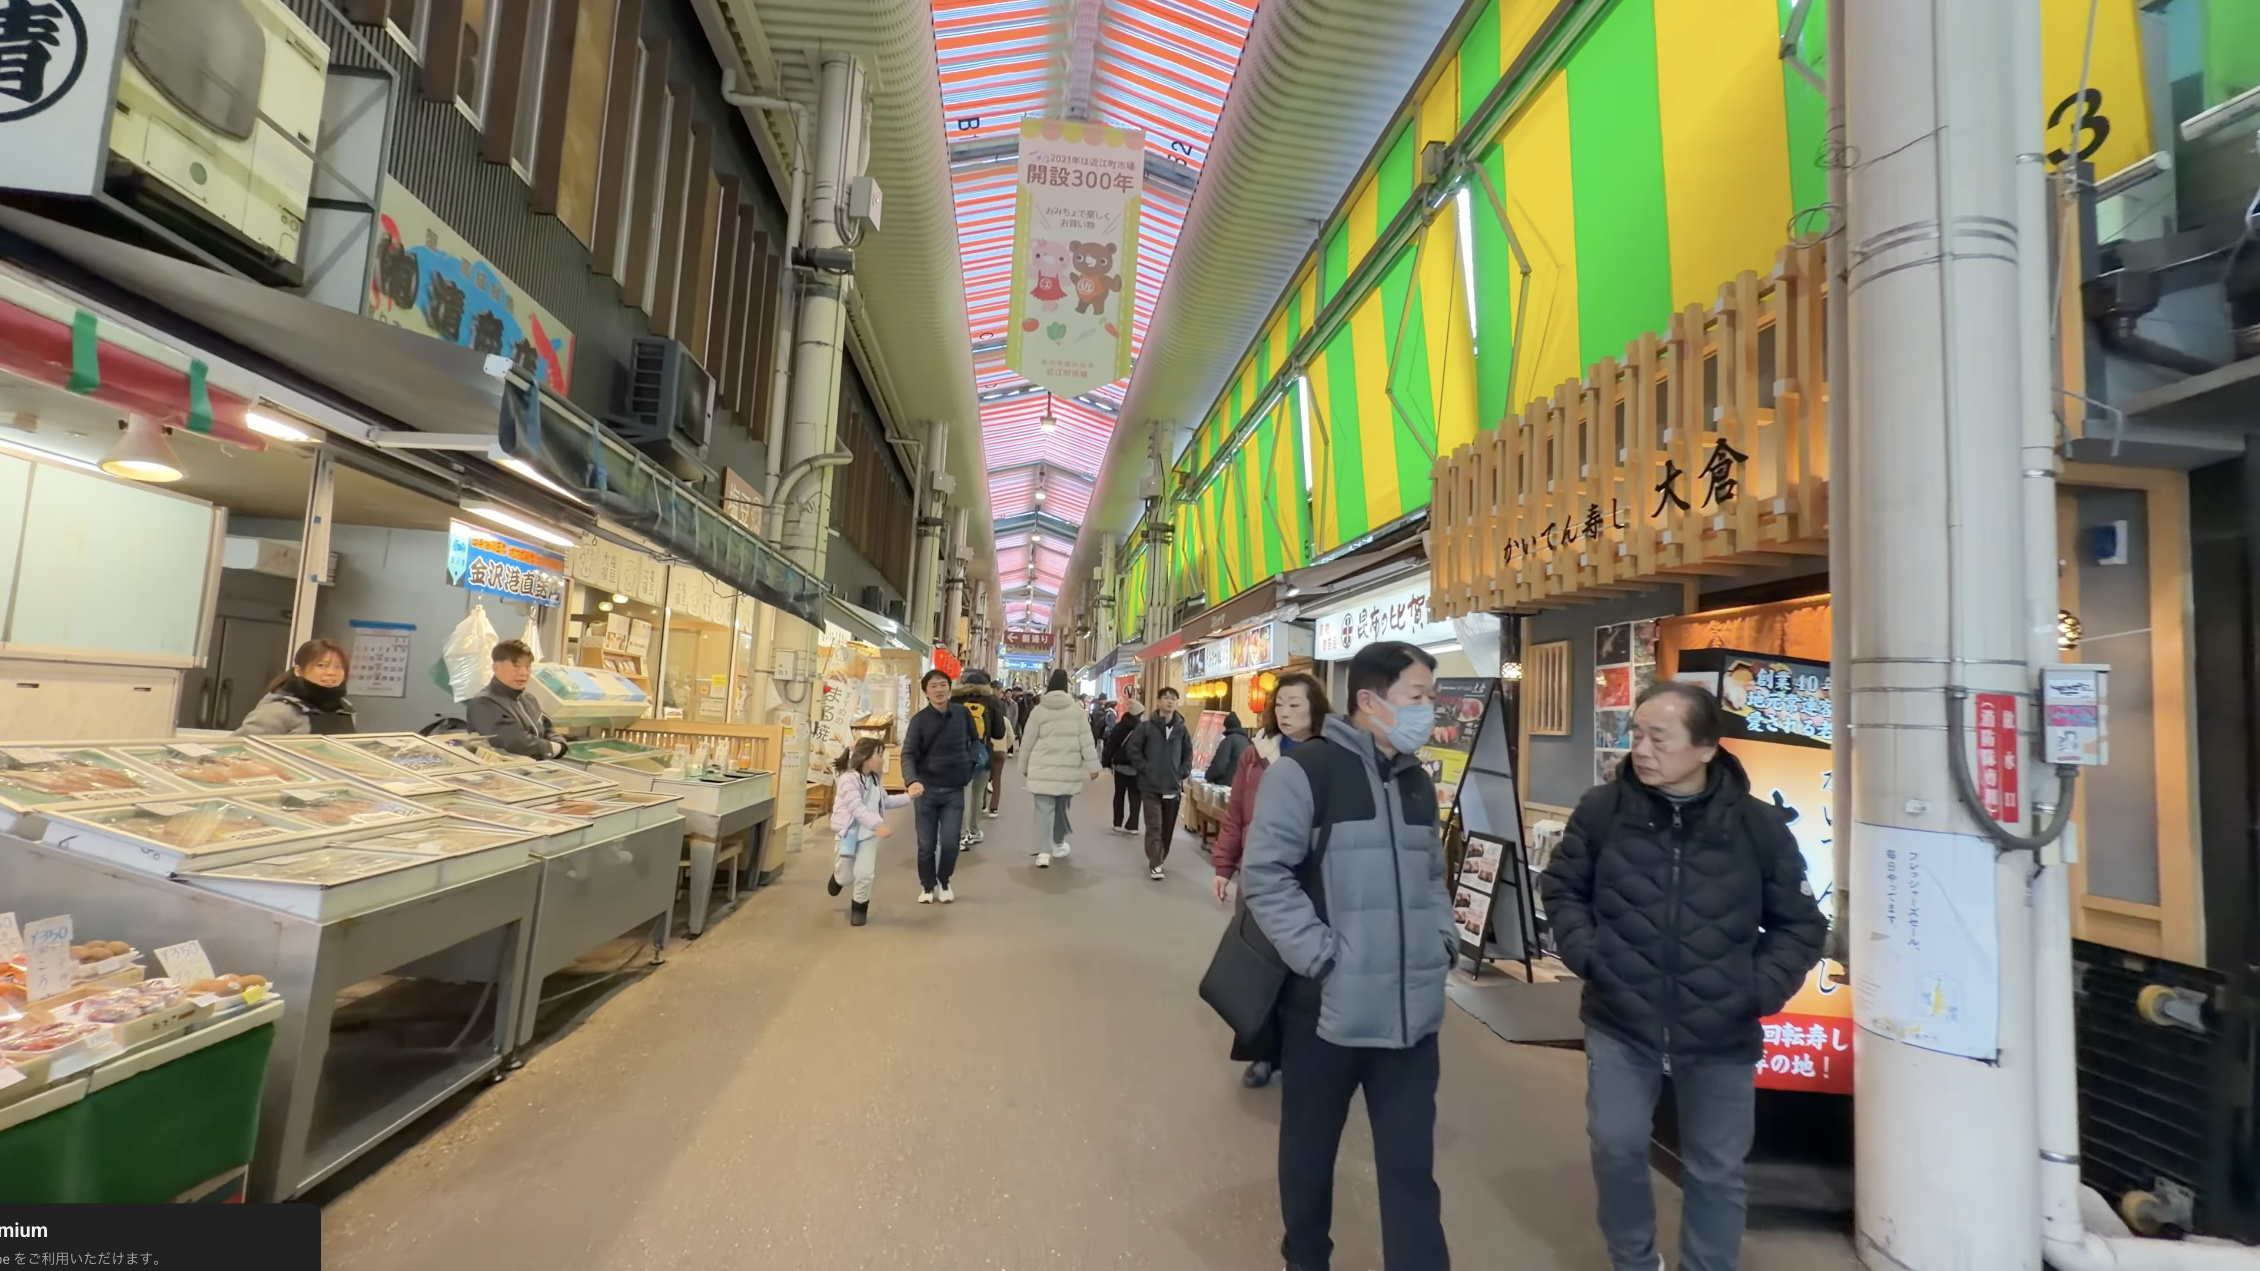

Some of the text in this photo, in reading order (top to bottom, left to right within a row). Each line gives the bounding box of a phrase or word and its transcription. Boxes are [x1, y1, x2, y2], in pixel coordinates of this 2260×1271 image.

[2047, 88, 2110, 165] 3
[1027, 164, 1134, 194] 開設300年
[1503, 438, 1749, 564] かいてん寿し 大倉
